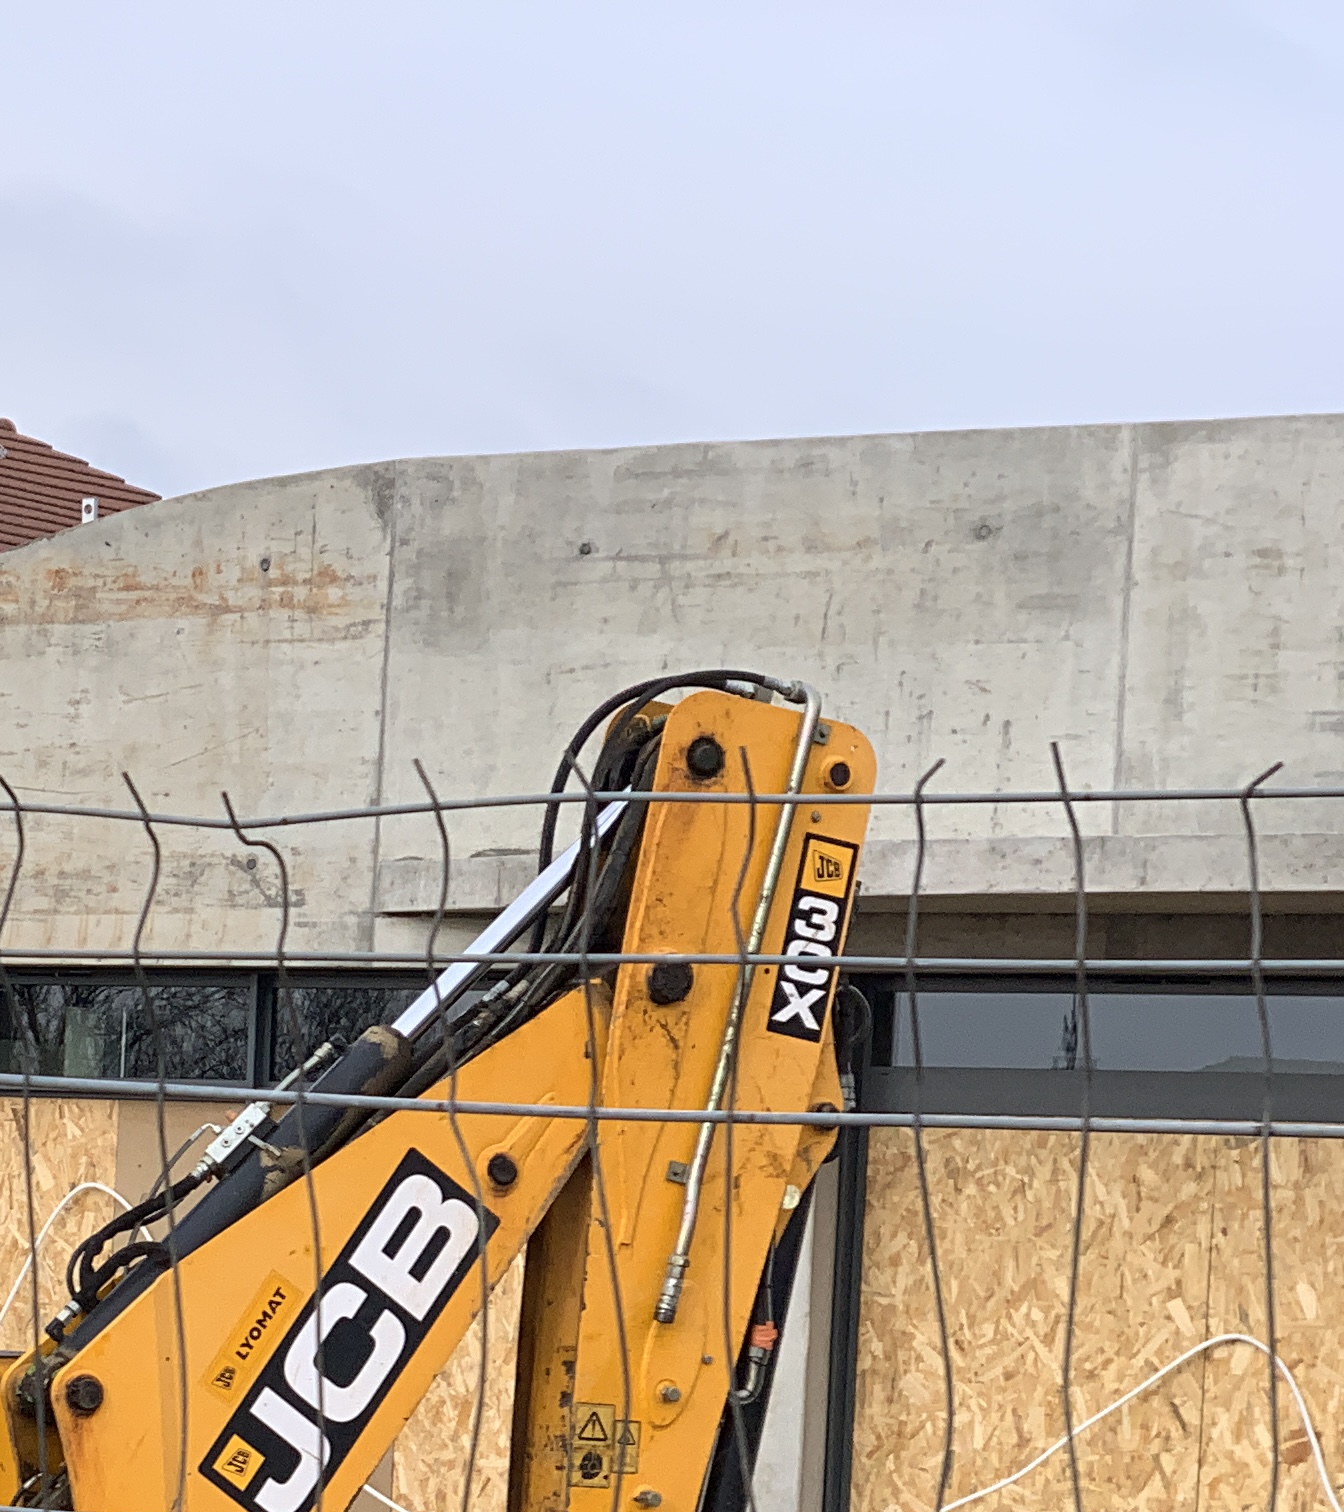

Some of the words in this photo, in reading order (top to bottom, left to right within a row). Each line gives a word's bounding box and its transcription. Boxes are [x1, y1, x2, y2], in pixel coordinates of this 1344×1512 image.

[817, 854, 841, 879] JCB
[772, 897, 839, 1031] 3CX
[235, 1286, 288, 1361] LYOMAT
[215, 1365, 237, 1391] JCB
[226, 1448, 252, 1474] JCB
